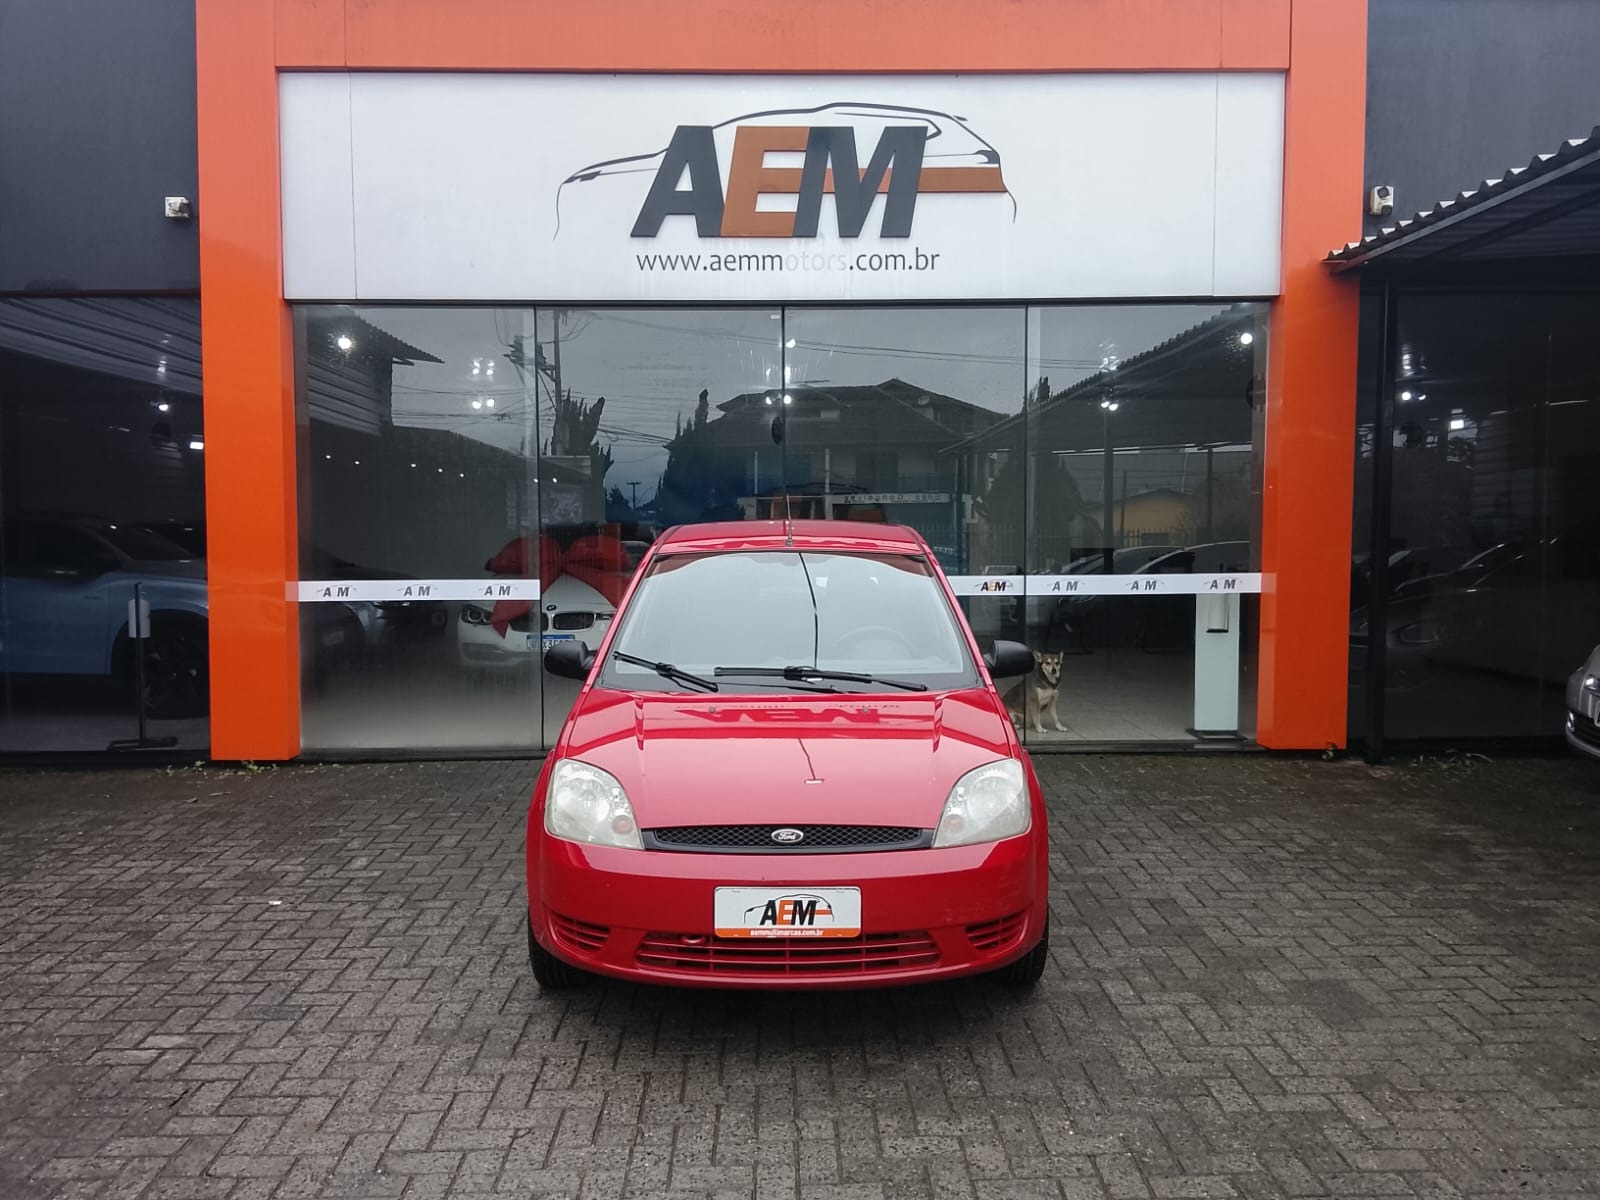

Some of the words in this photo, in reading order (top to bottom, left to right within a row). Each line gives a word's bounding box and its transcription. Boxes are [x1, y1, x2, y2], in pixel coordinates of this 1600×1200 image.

[630, 125, 928, 238] AEM
[636, 247, 940, 271] www.aemmotors.com.br
[776, 830, 798, 841] Ford
[760, 899, 817, 926] AEM
